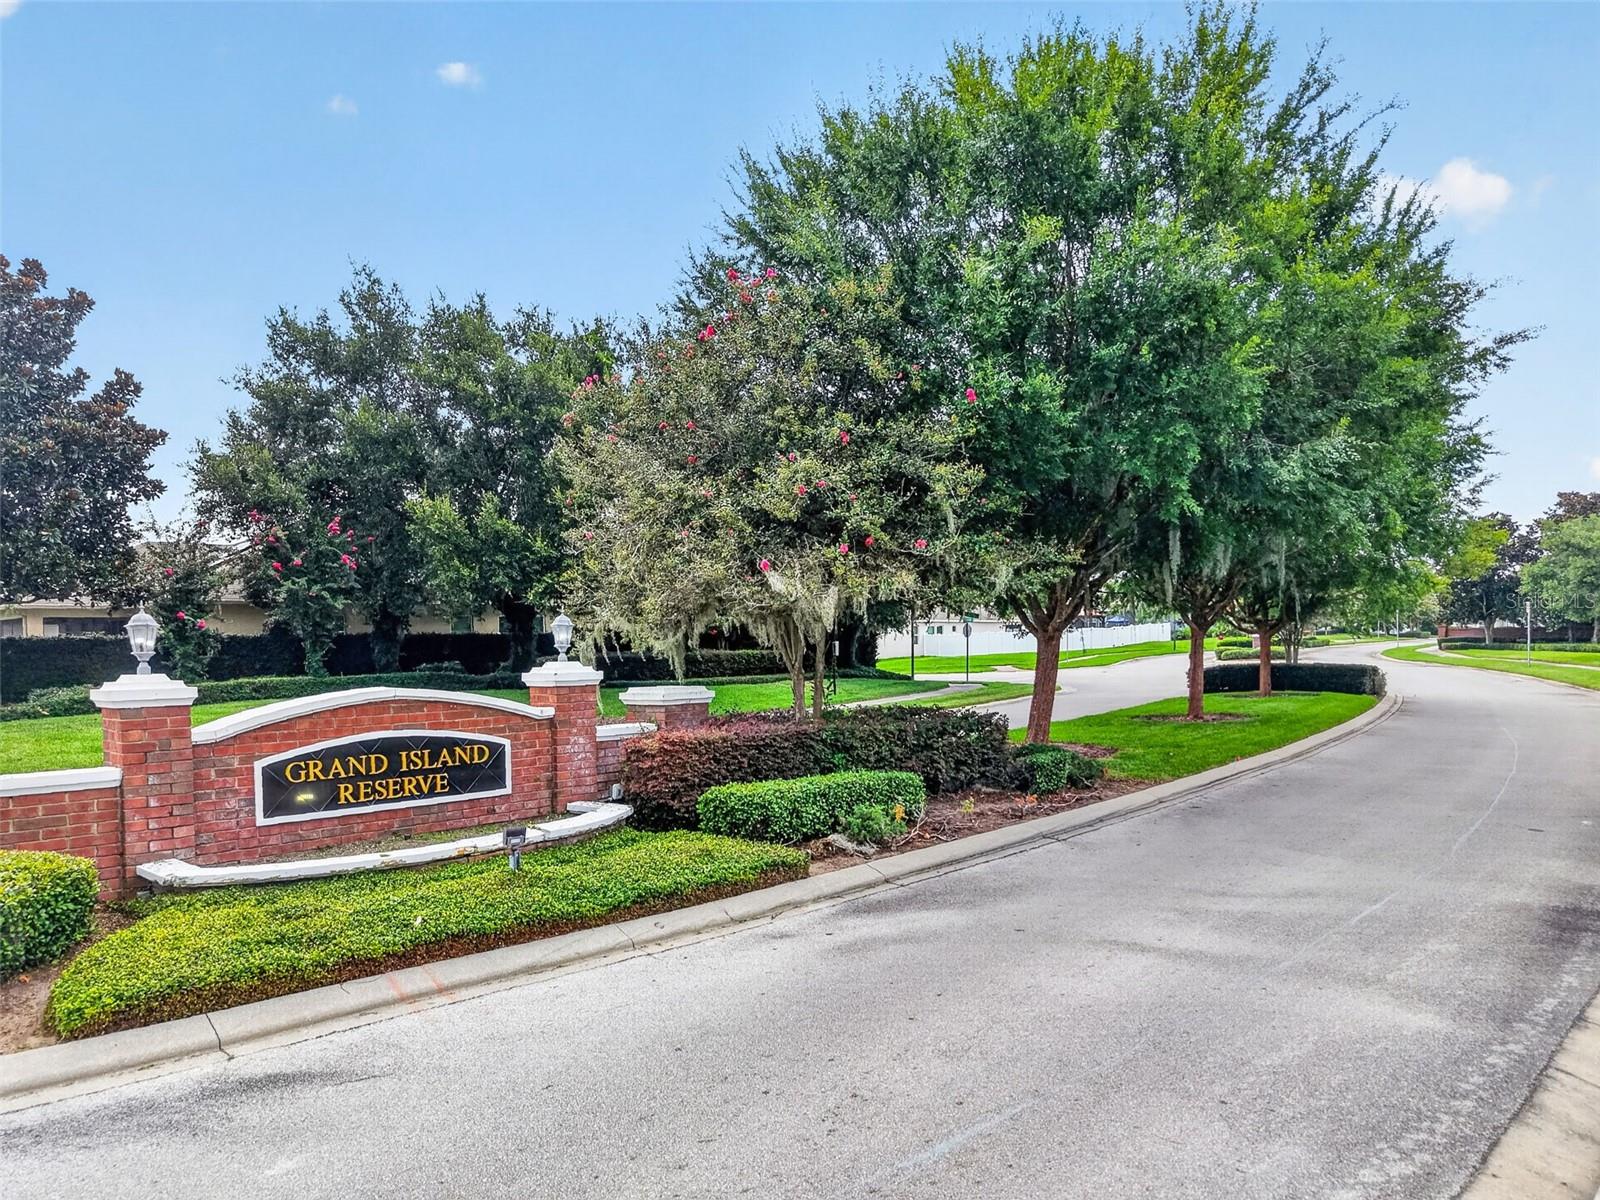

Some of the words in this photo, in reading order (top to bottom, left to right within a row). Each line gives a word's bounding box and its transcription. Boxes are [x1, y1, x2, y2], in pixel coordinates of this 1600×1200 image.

[284, 753, 389, 784] GRAND
[399, 744, 490, 771] ISLAND
[337, 773, 450, 805] RESERVE
